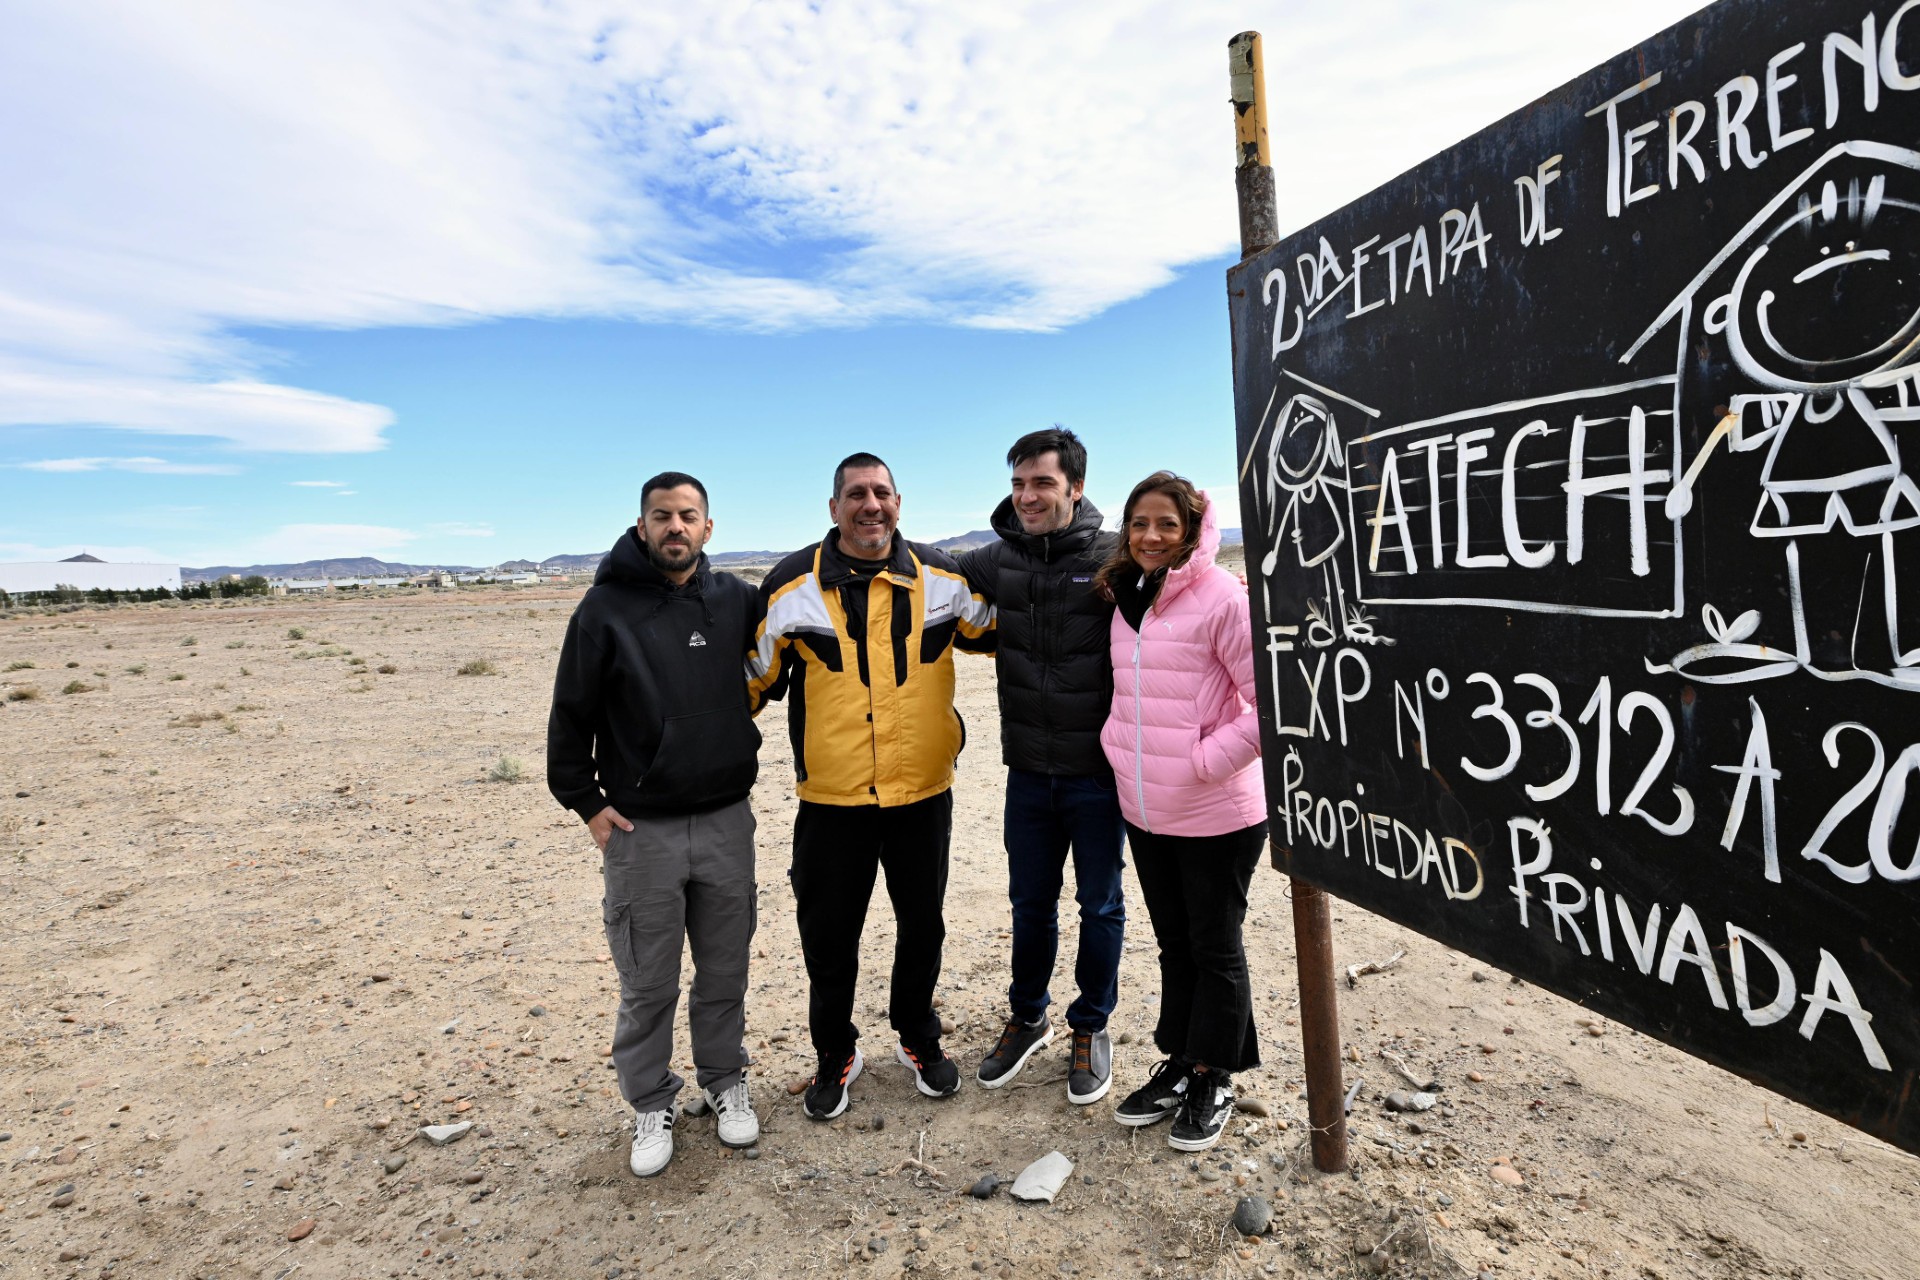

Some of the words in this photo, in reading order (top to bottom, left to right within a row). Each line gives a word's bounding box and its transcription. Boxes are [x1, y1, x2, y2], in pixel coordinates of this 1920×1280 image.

[1346, 201, 1492, 319] ETAPA
[1515, 154, 1563, 245] DE
[1366, 405, 1672, 576] ATECH
[1266, 625, 1371, 747] EXP
[1461, 672, 1695, 836] 3312
[1711, 695, 1782, 883] A
[1801, 721, 1920, 884] 20
